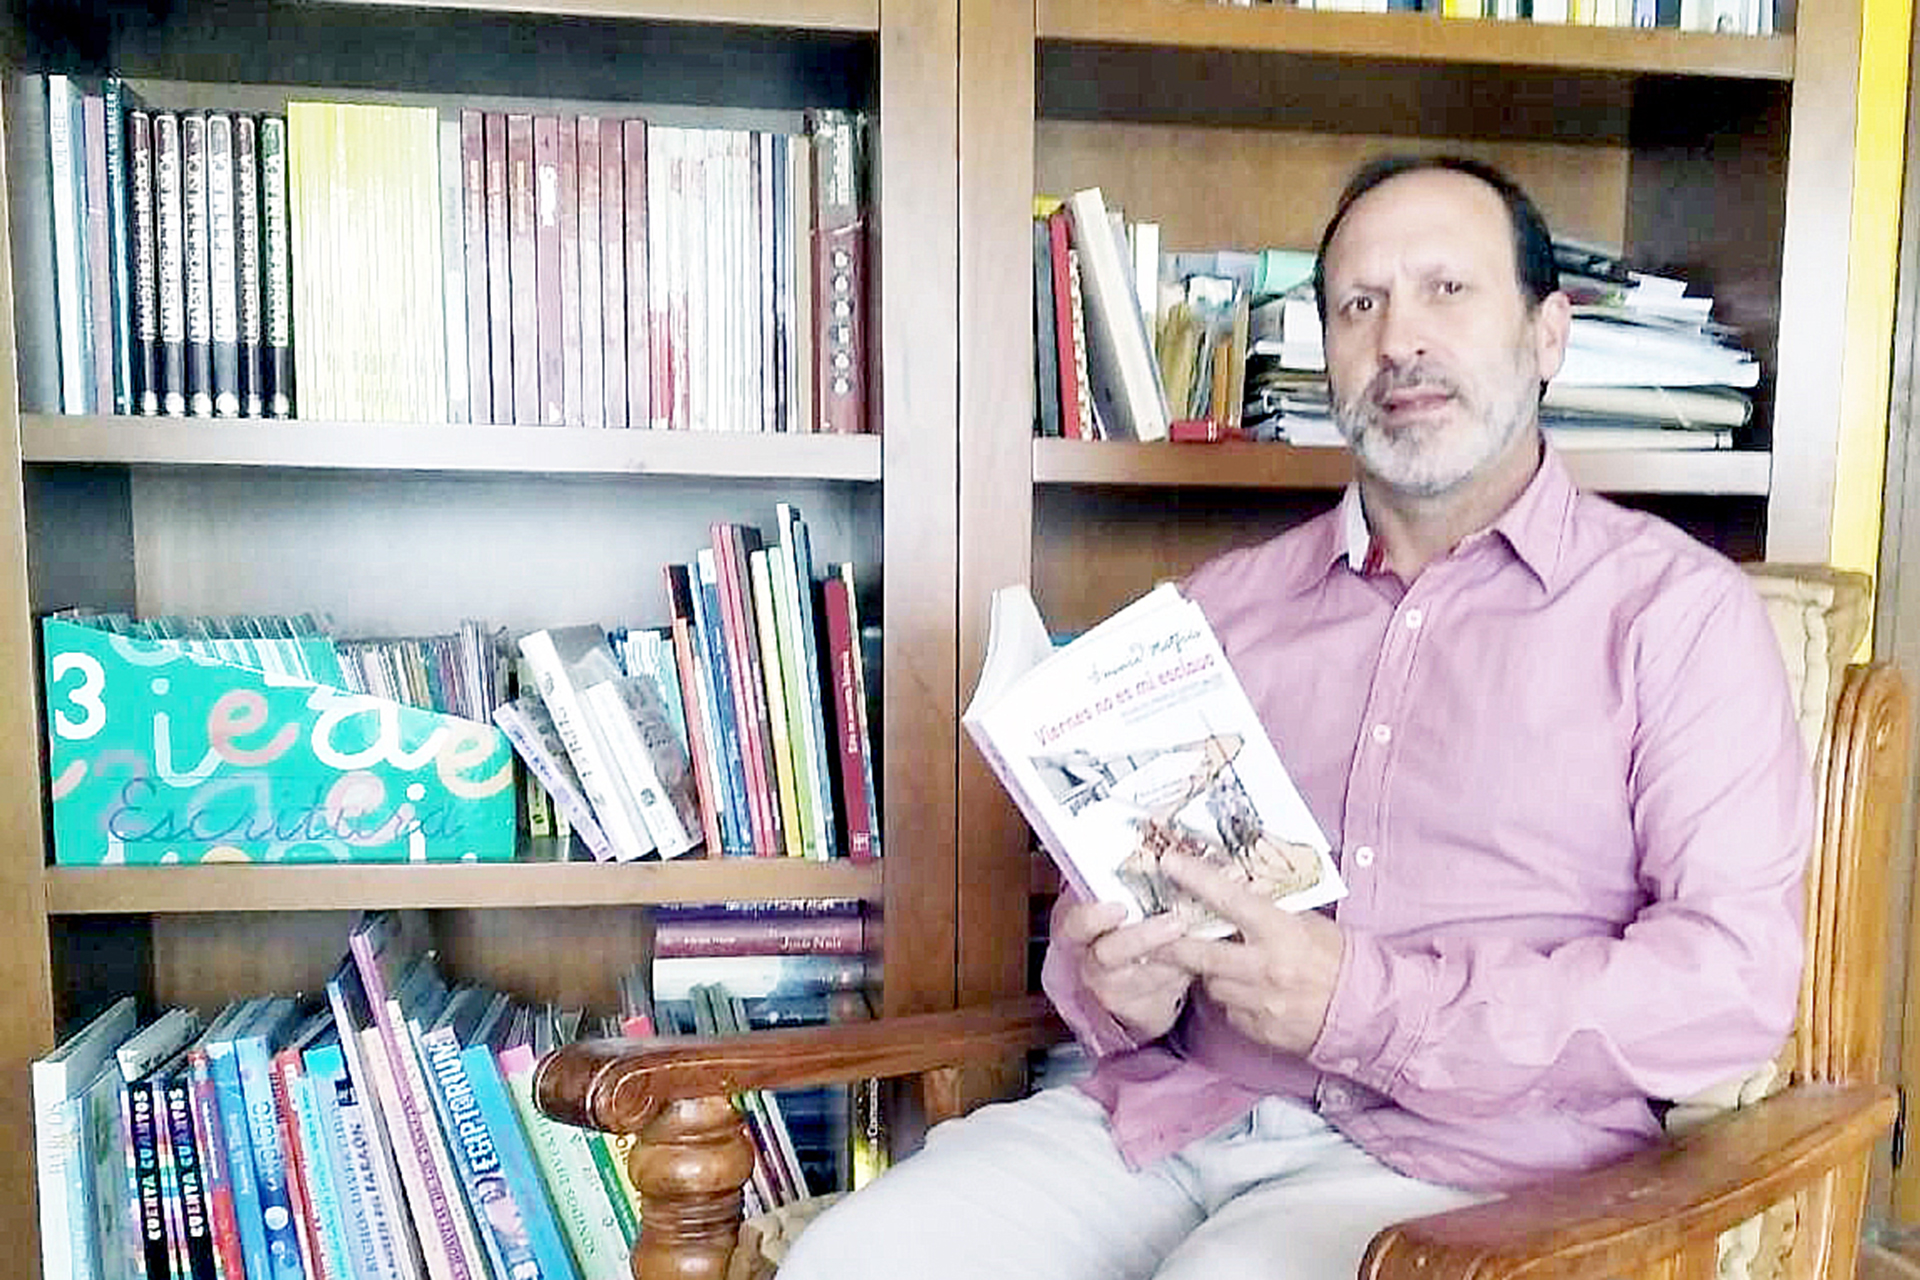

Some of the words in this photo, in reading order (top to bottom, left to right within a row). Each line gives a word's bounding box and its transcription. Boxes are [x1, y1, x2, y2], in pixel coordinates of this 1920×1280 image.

[53, 652, 106, 740] 3
[1034, 707, 1093, 747] Viernes
[1095, 697, 1114, 715] no
[1116, 688, 1133, 703] es
[1136, 670, 1155, 696] mi
[142, 1174, 161, 1241] CUENTA
[181, 1171, 205, 1238] CUENTA
